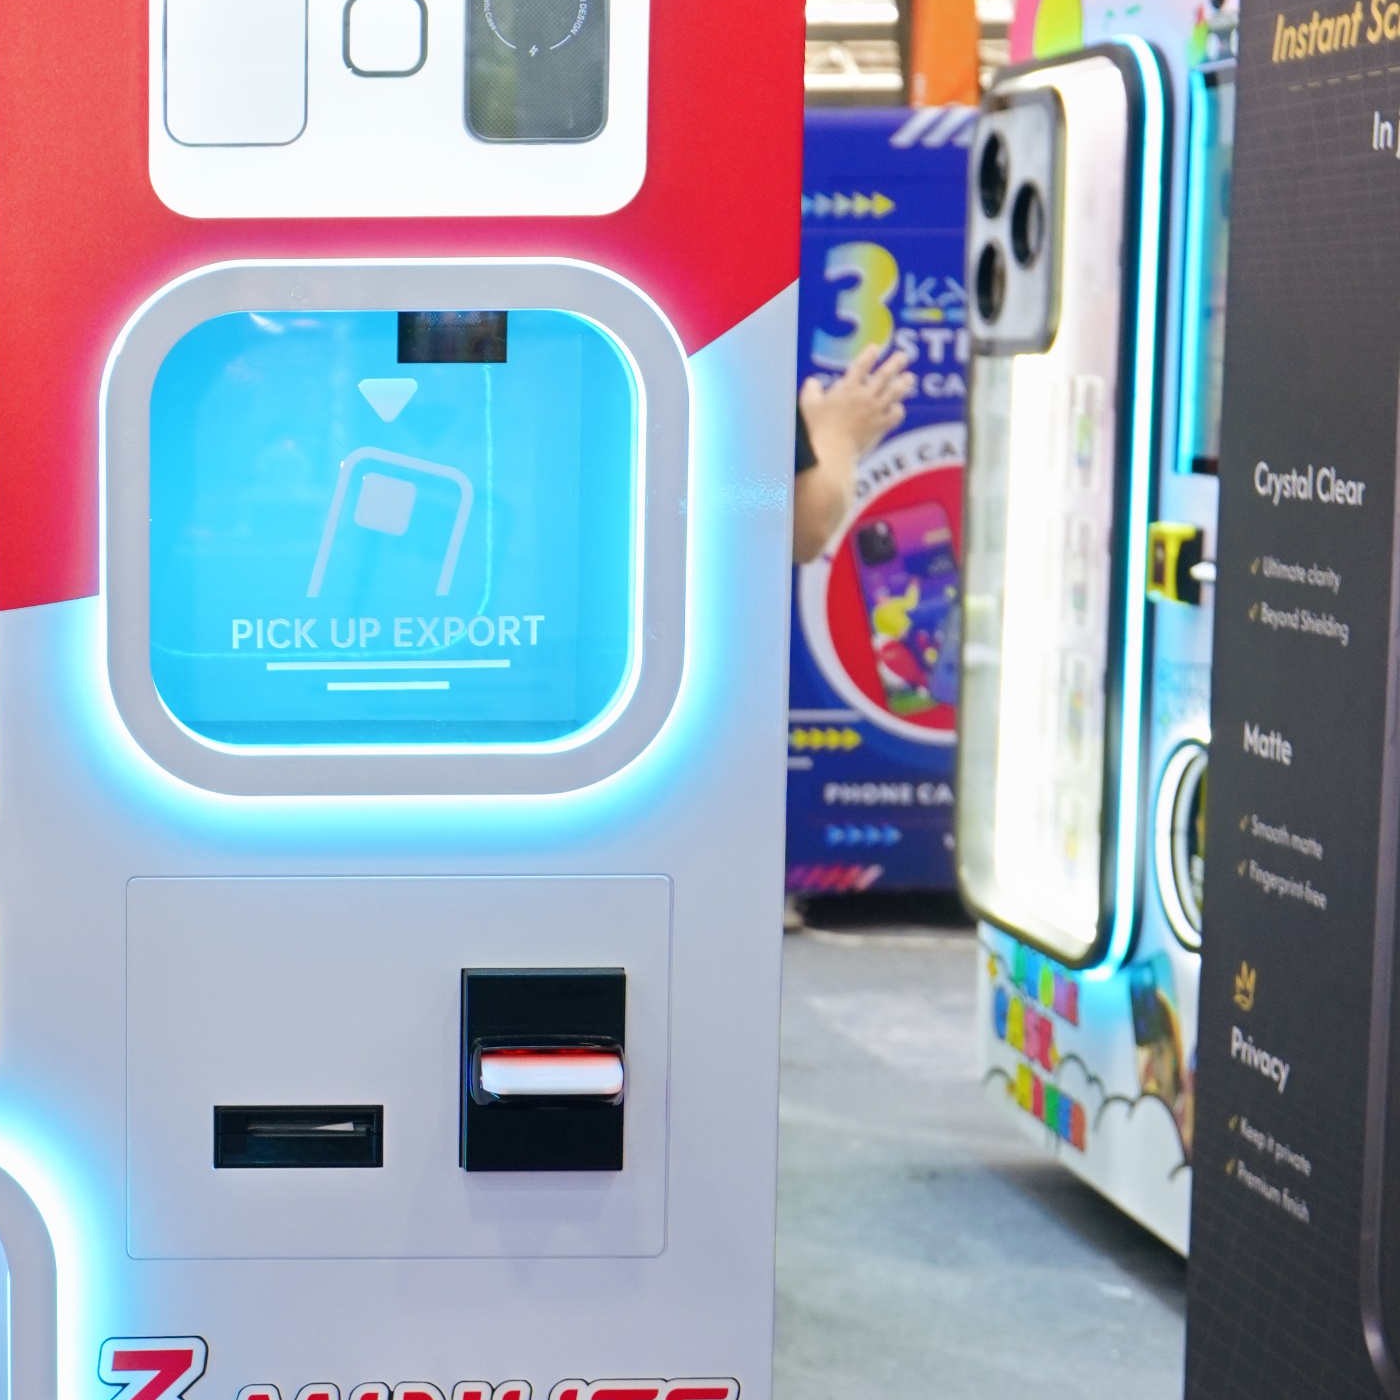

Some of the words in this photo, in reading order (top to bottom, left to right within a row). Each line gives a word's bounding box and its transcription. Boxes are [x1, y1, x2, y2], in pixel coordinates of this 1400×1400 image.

[570, 3, 588, 35] DESIGN
[1272, 0, 1364, 63] Instant
[1372, 110, 1394, 150] In
[811, 241, 899, 370] 3
[1254, 460, 1314, 506] Crystal
[1316, 466, 1367, 506] Clear
[231, 617, 318, 650] PICK
[330, 617, 382, 649] UP
[393, 615, 546, 648] EXPORT
[1243, 720, 1293, 766] Matte
[1231, 1025, 1291, 1094] Privacy
